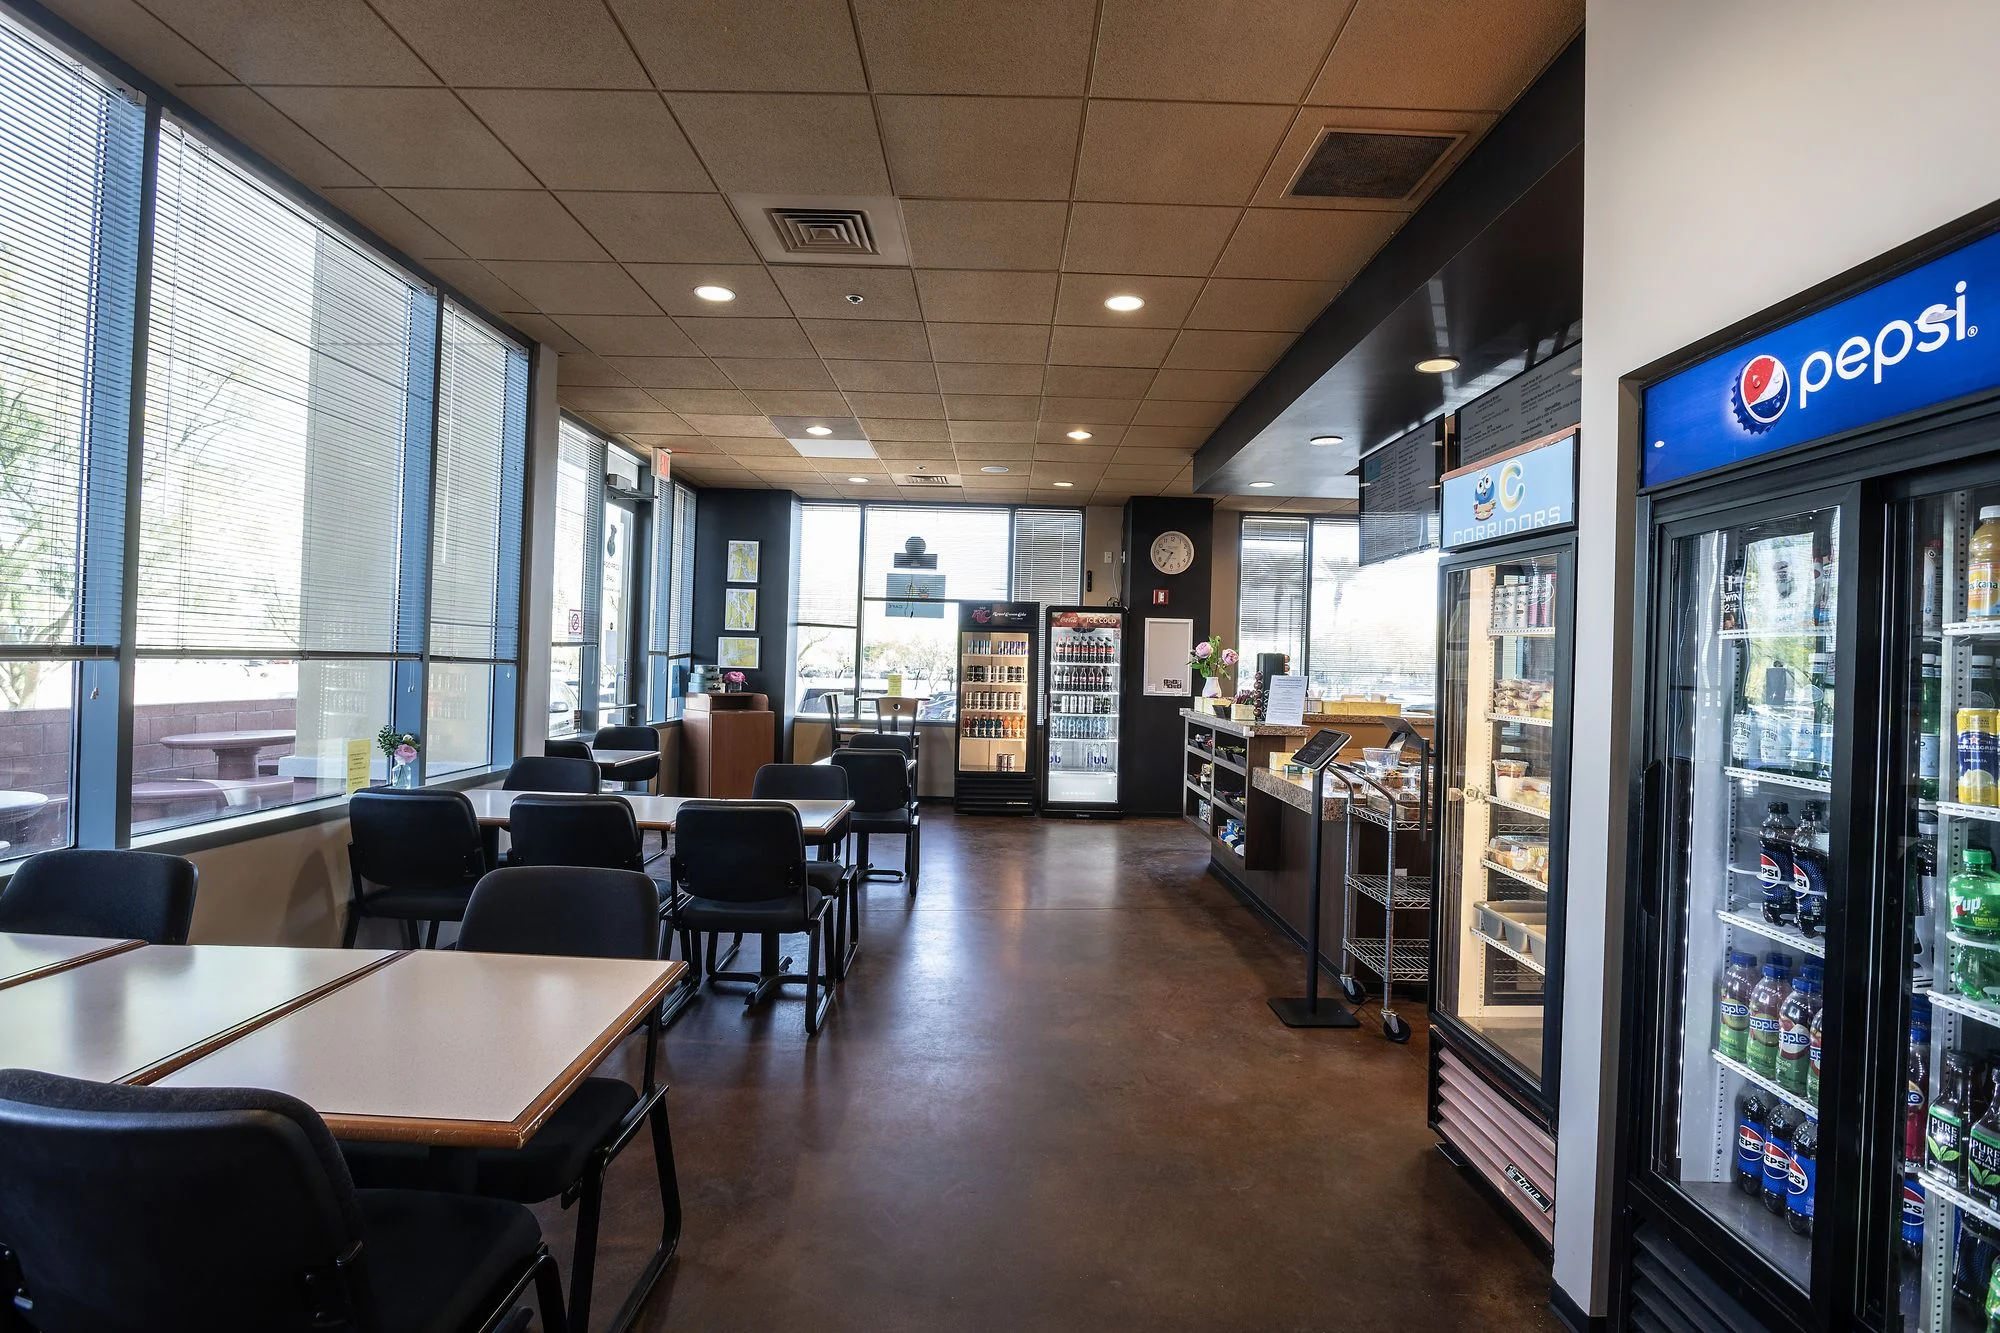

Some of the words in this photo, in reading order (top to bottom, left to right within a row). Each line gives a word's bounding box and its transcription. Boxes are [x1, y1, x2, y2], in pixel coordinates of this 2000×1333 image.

[1799, 280, 1967, 409] pepsi
[1453, 506, 1561, 546] CORRIDORS
[1721, 1003, 1746, 1015] apple
[1750, 1018, 1779, 1031] apple
[1931, 1117, 1957, 1134] PURE
[1740, 1138, 1763, 1152] EPSI
[1972, 1139, 2000, 1158] PURE
[1765, 1154, 1790, 1170] EPSI
[1972, 1148, 2000, 1167] LEAF
[1789, 1171, 1806, 1187] PSI
